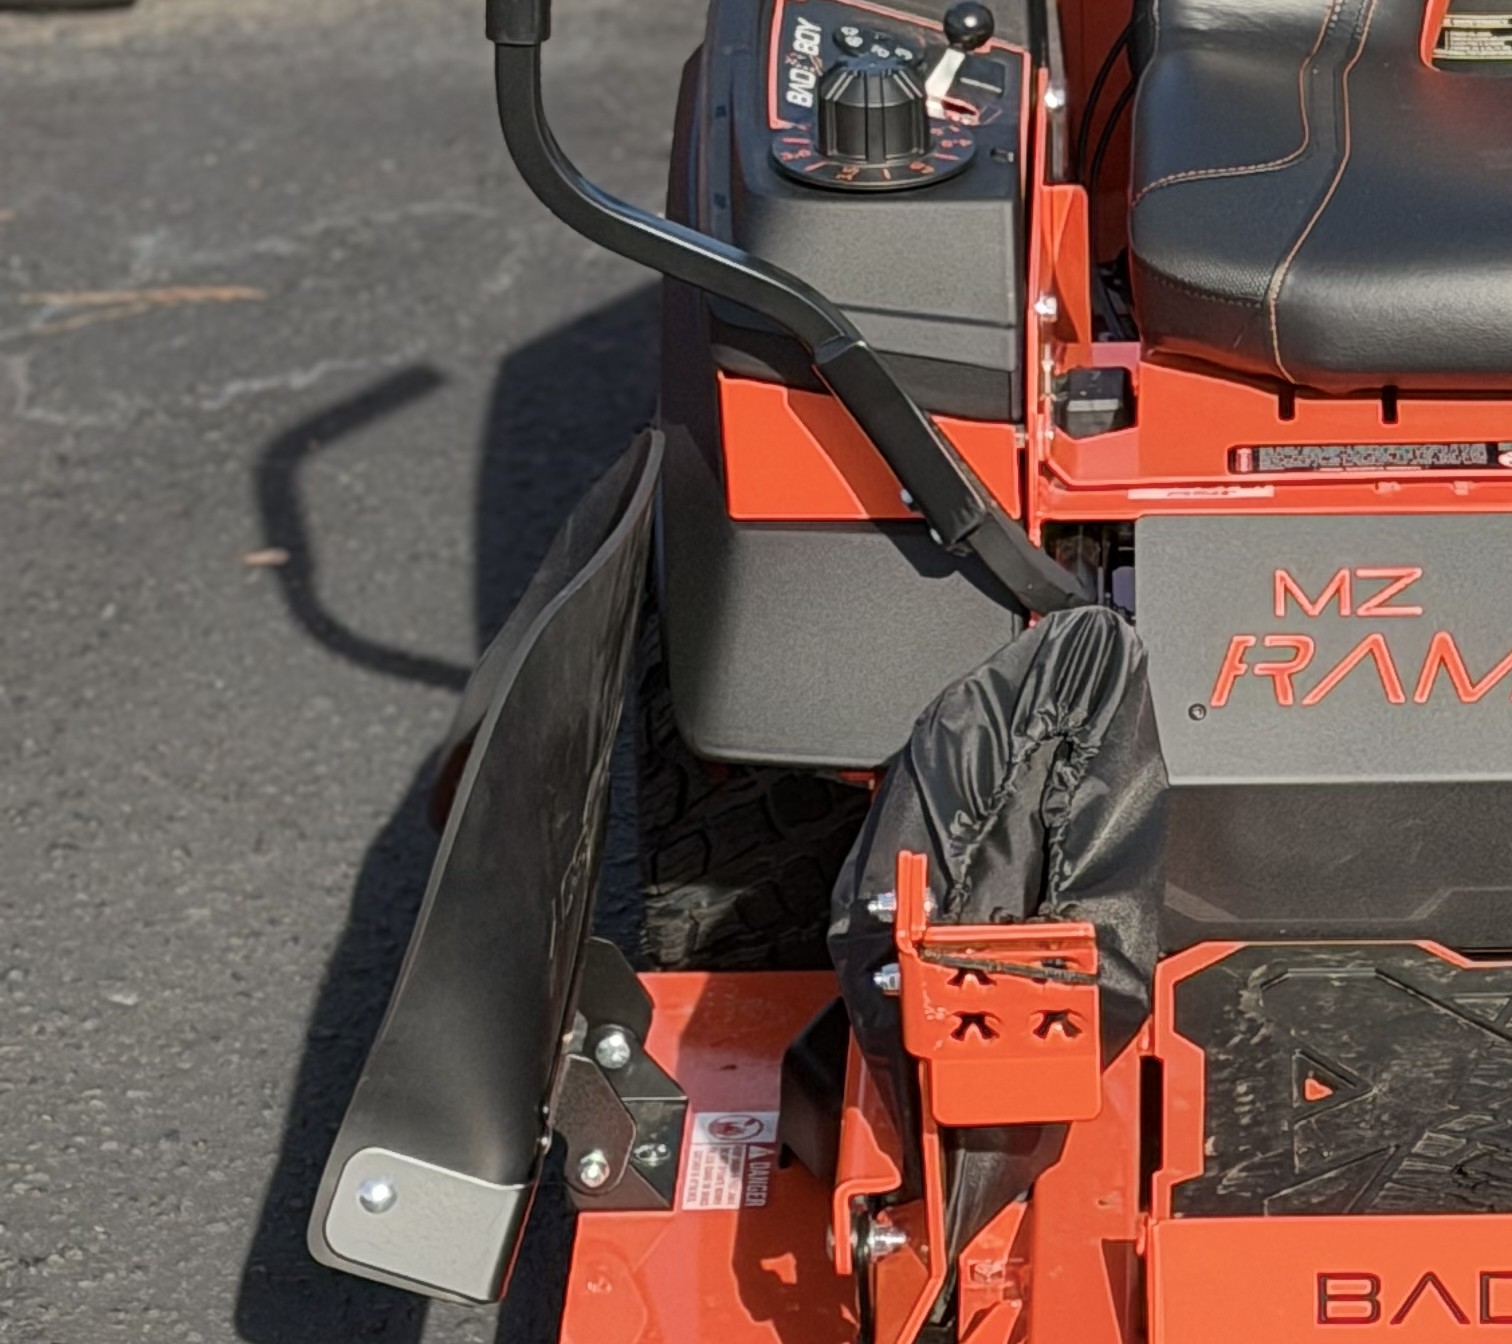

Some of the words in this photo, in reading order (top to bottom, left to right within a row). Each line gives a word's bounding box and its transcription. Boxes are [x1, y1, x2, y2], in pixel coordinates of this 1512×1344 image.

[792, 16, 822, 57] BOY
[786, 67, 816, 108] BAD
[1274, 568, 1424, 618] MZ
[744, 1161, 772, 1208] DANGER
